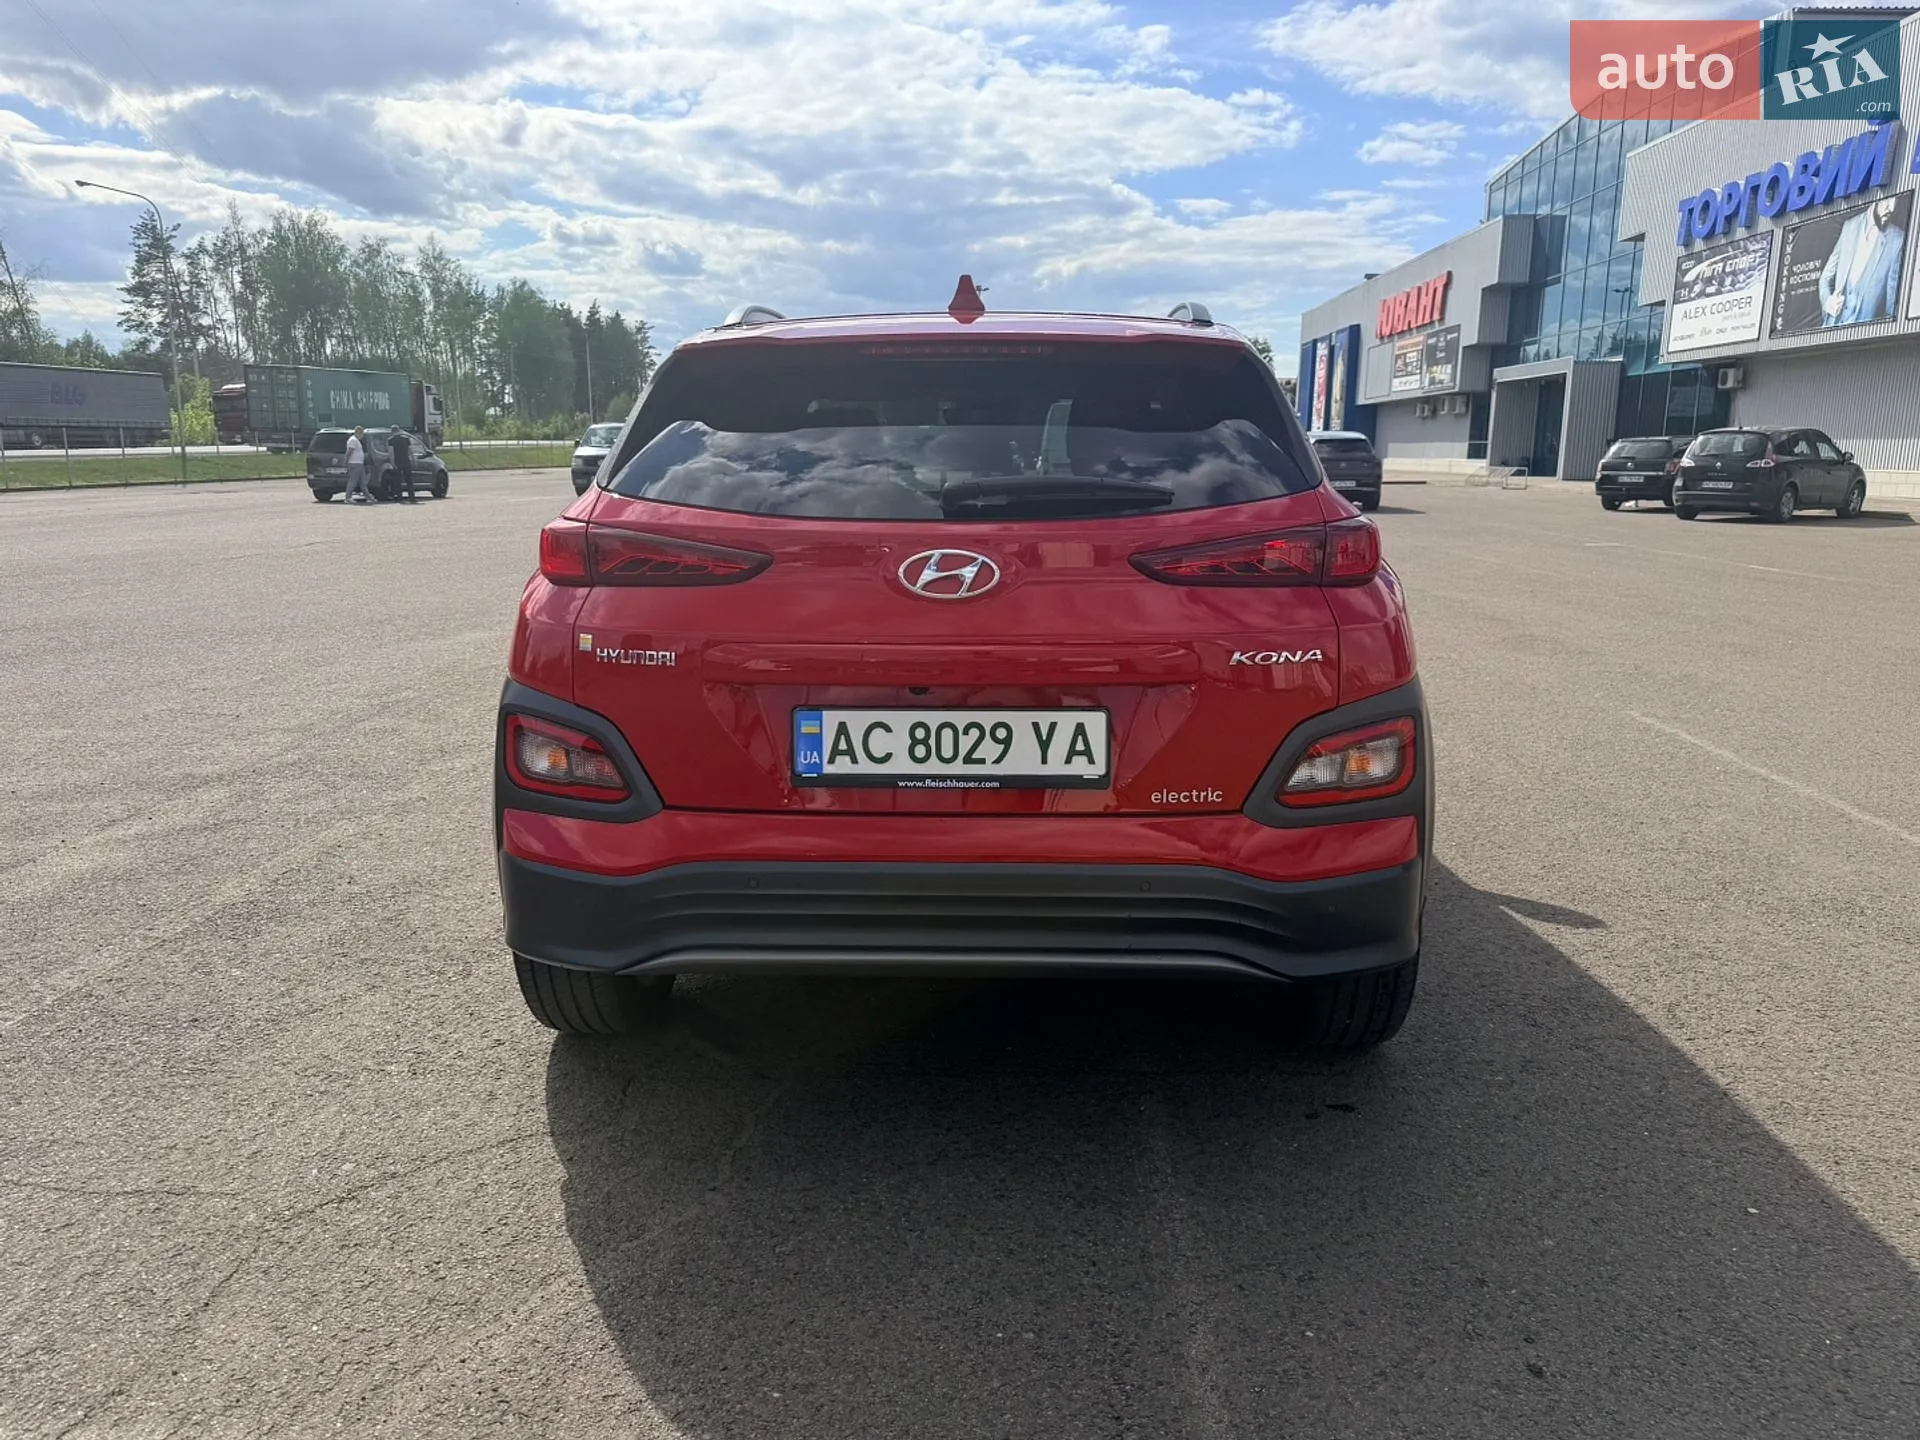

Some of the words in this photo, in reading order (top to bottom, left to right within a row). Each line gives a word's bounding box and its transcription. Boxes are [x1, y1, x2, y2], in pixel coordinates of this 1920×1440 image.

[1676, 118, 1894, 246] ТОРГОВИЙ
[1376, 273, 1449, 339] ЮВАНТ
[1681, 304, 1708, 320] ALEX
[1710, 296, 1753, 315] COOPER
[596, 648, 676, 666] HYUNDAI
[1229, 649, 1323, 665] KONA
[827, 721, 893, 765] AC
[908, 721, 1013, 765] 8029
[1032, 721, 1096, 765] YA
[801, 750, 820, 764] UA
[897, 779, 1000, 788] www.fleischhauer.com
[1151, 787, 1223, 804] electric
